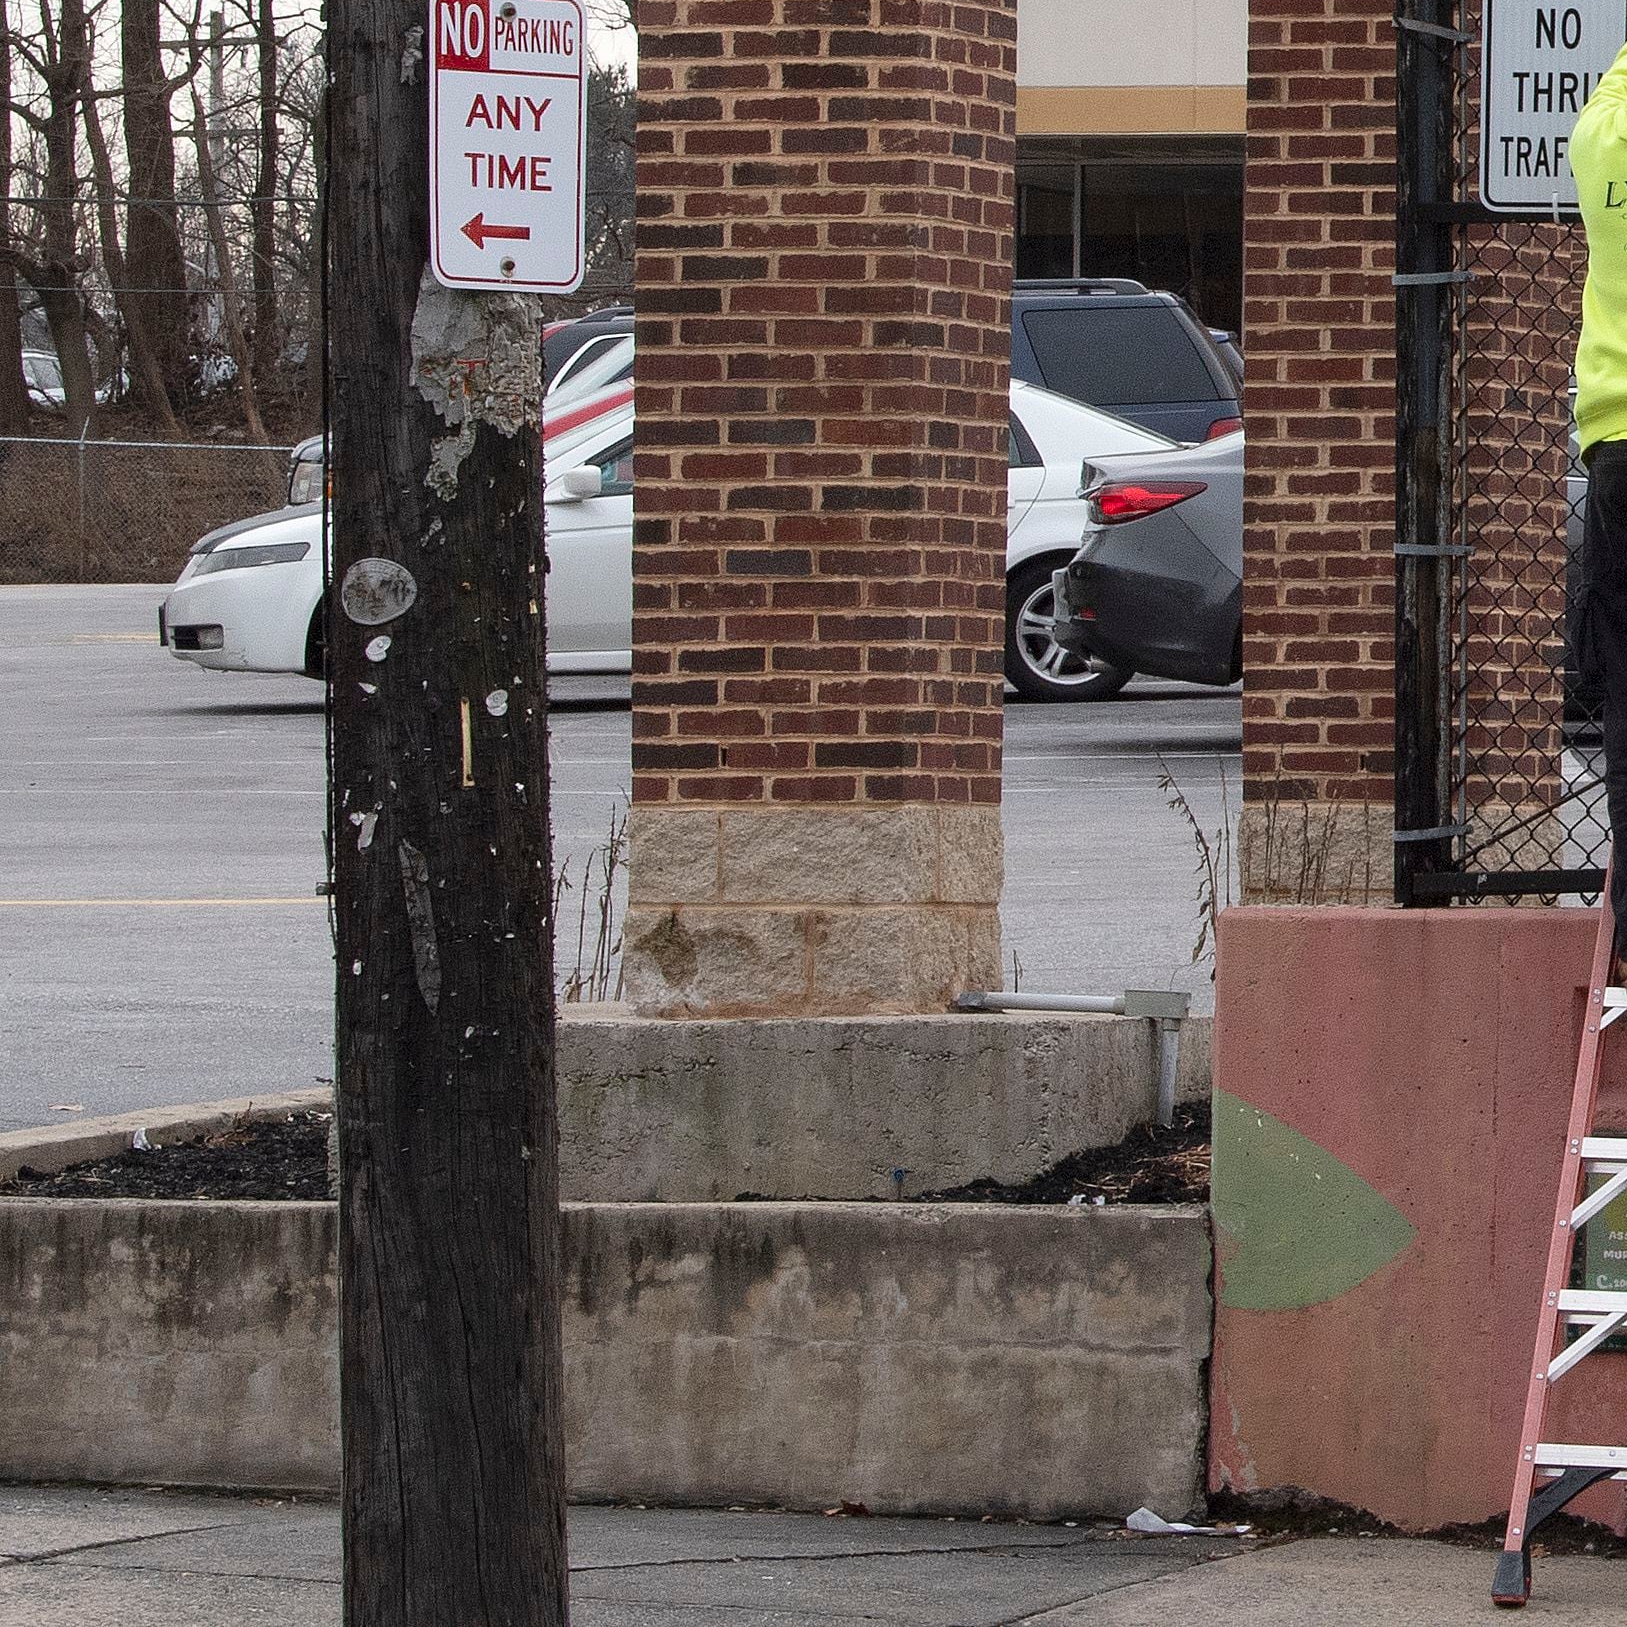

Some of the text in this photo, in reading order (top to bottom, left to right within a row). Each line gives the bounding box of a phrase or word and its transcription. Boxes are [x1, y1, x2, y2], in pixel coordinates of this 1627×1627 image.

[440, 2, 574, 58] NO PARKING
[1535, 8, 1582, 50] NO
[465, 93, 552, 132] ANY
[464, 153, 552, 192] TIME
[1500, 136, 1574, 178] TRAF
